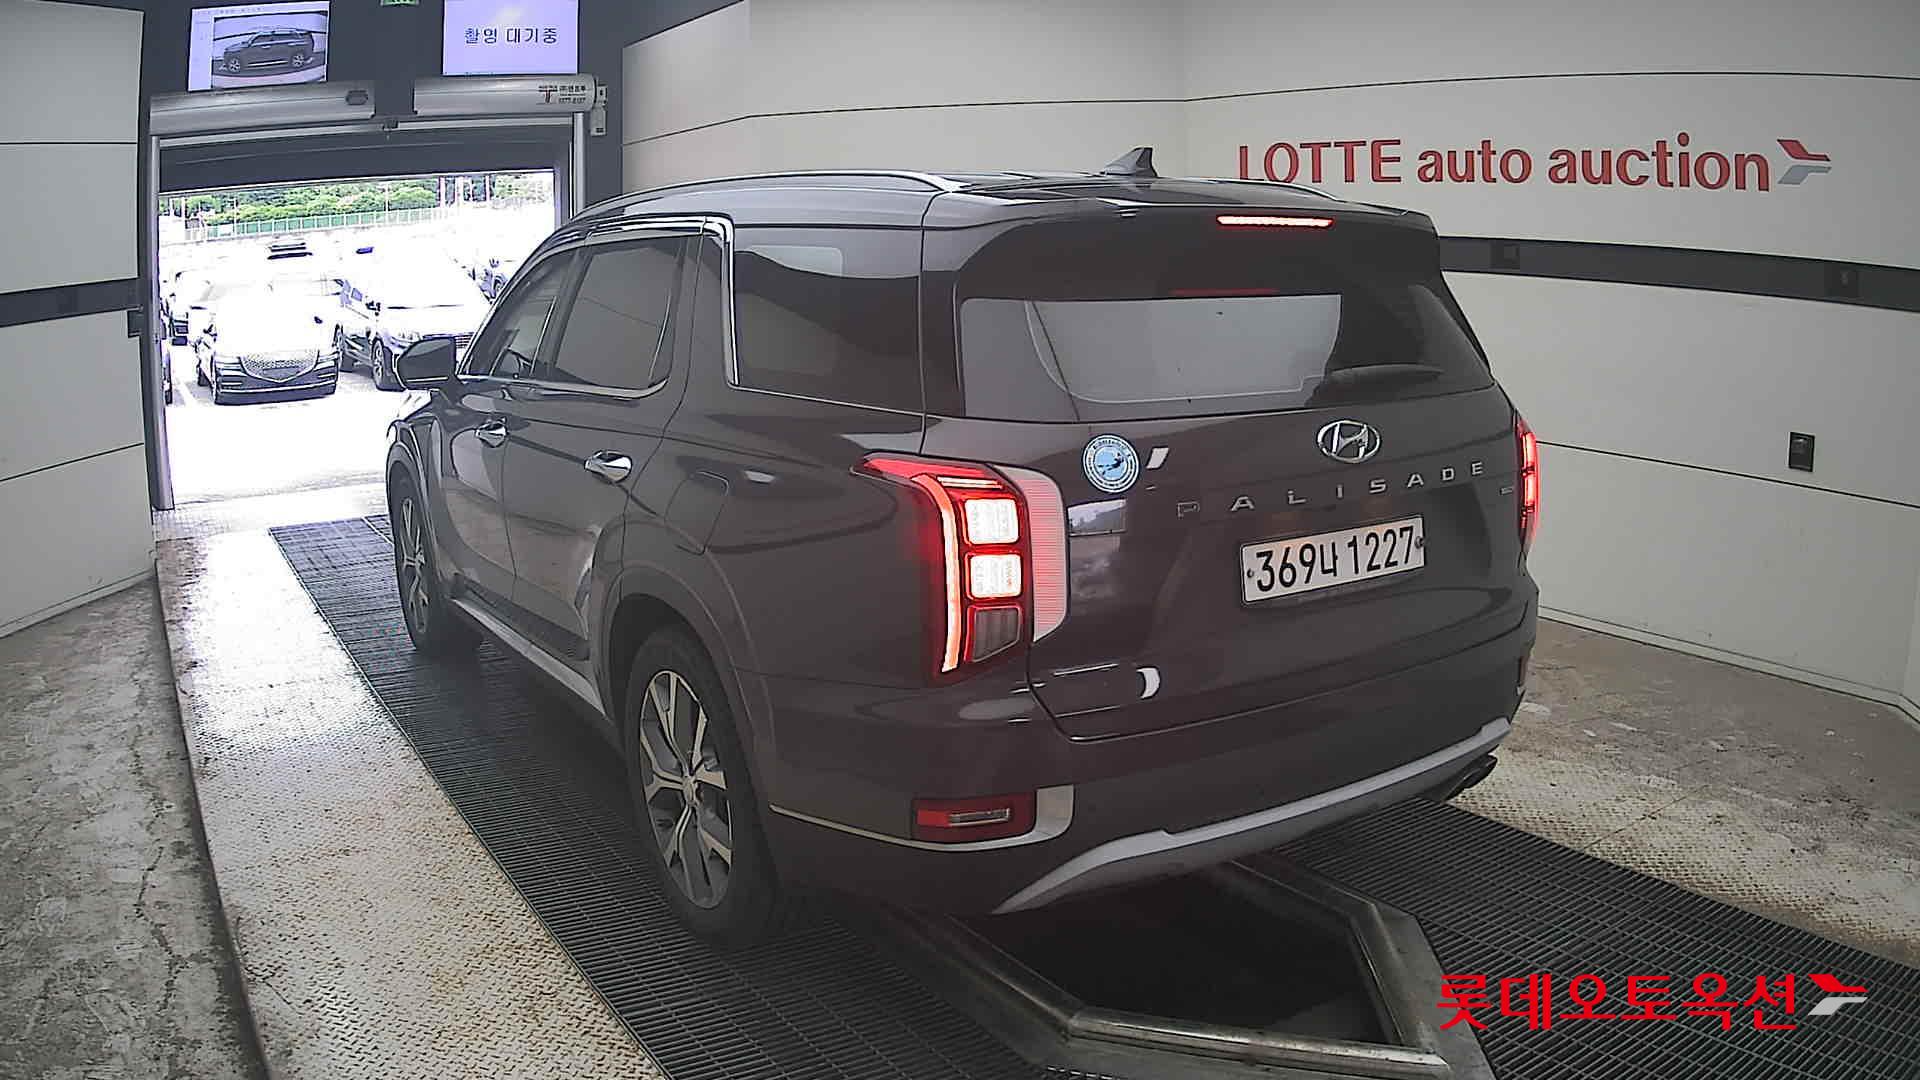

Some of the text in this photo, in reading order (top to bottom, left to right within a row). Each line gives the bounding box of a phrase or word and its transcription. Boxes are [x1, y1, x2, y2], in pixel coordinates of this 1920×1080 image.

[464, 27, 498, 44] 촬영
[1239, 132, 1770, 192] LOTTE auto auction
[1176, 461, 1484, 520] PALISADE
[1256, 525, 1414, 591] 369나 1227
